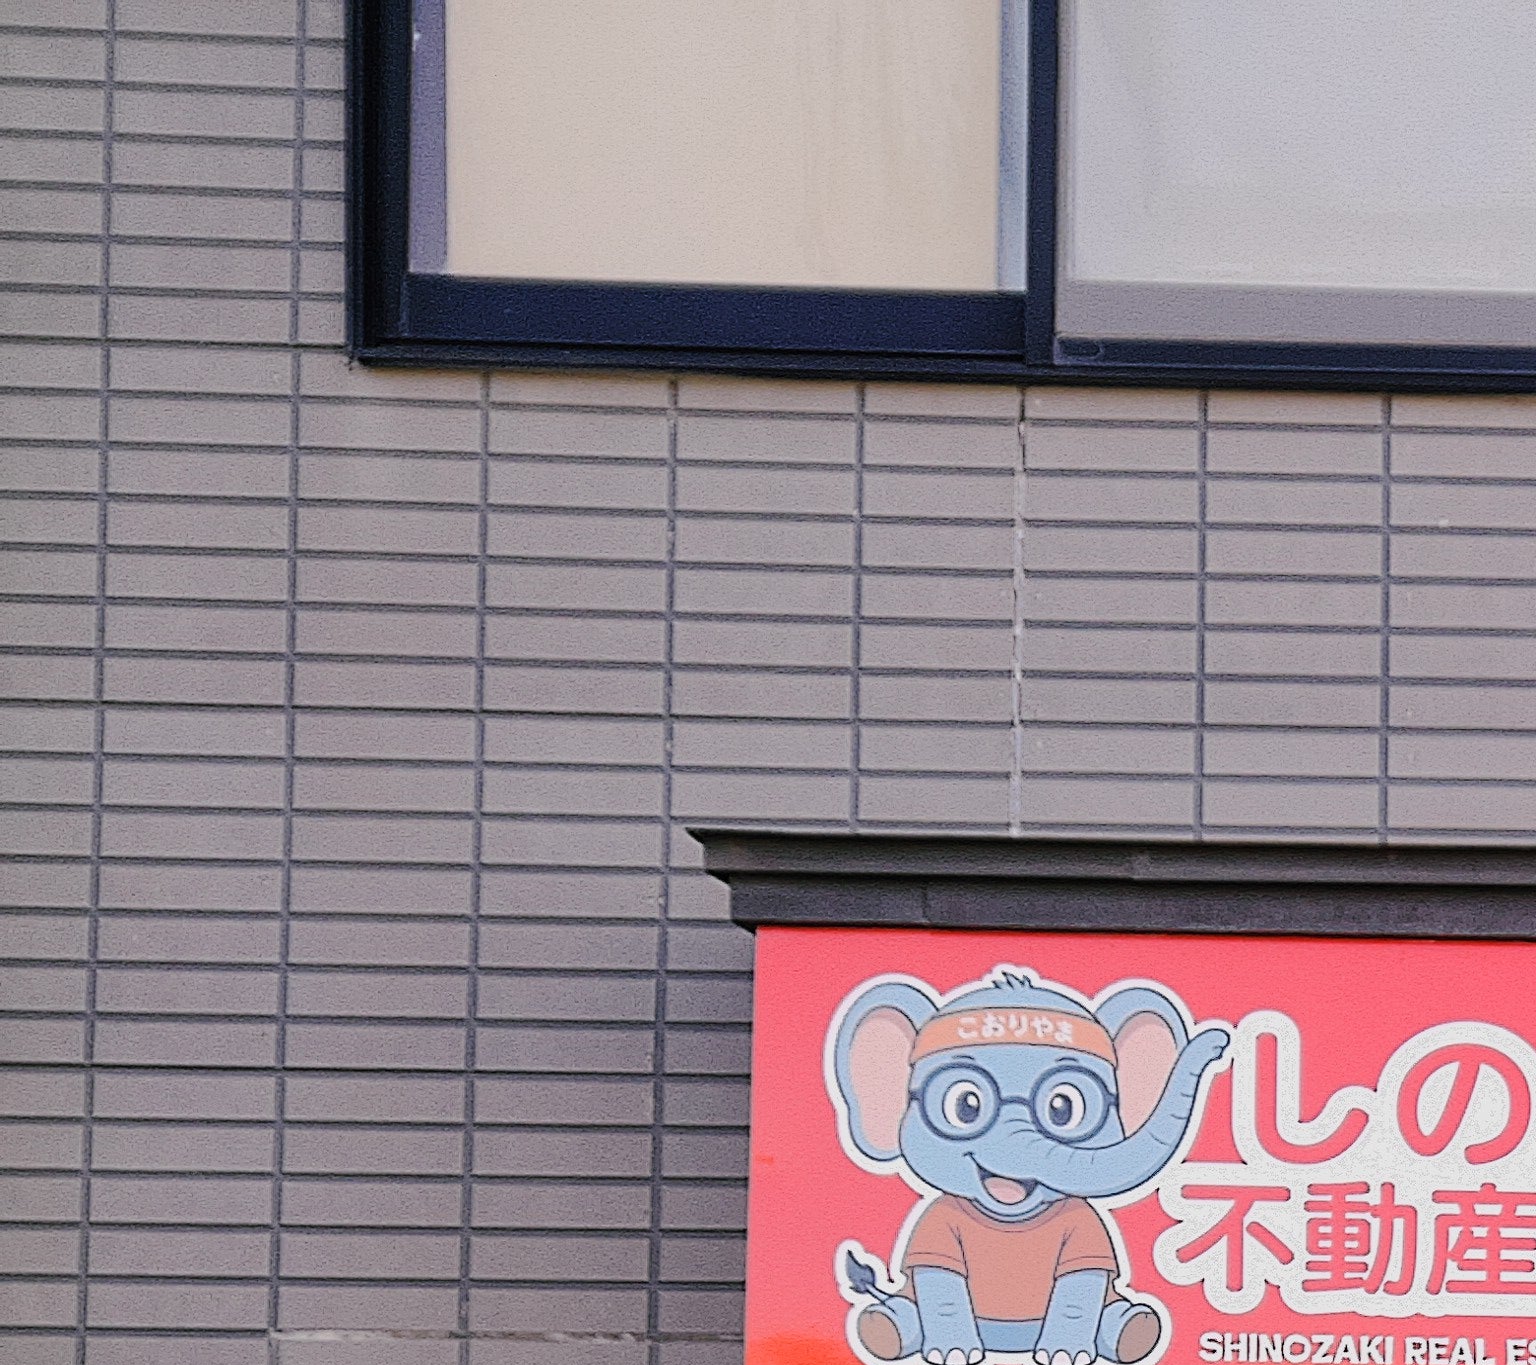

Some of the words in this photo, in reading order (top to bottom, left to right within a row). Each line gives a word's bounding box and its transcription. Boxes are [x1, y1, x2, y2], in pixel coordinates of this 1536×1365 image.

[957, 1011, 1072, 1044] こおりやま
[1199, 1332, 1394, 1365] SHINOZAKI
